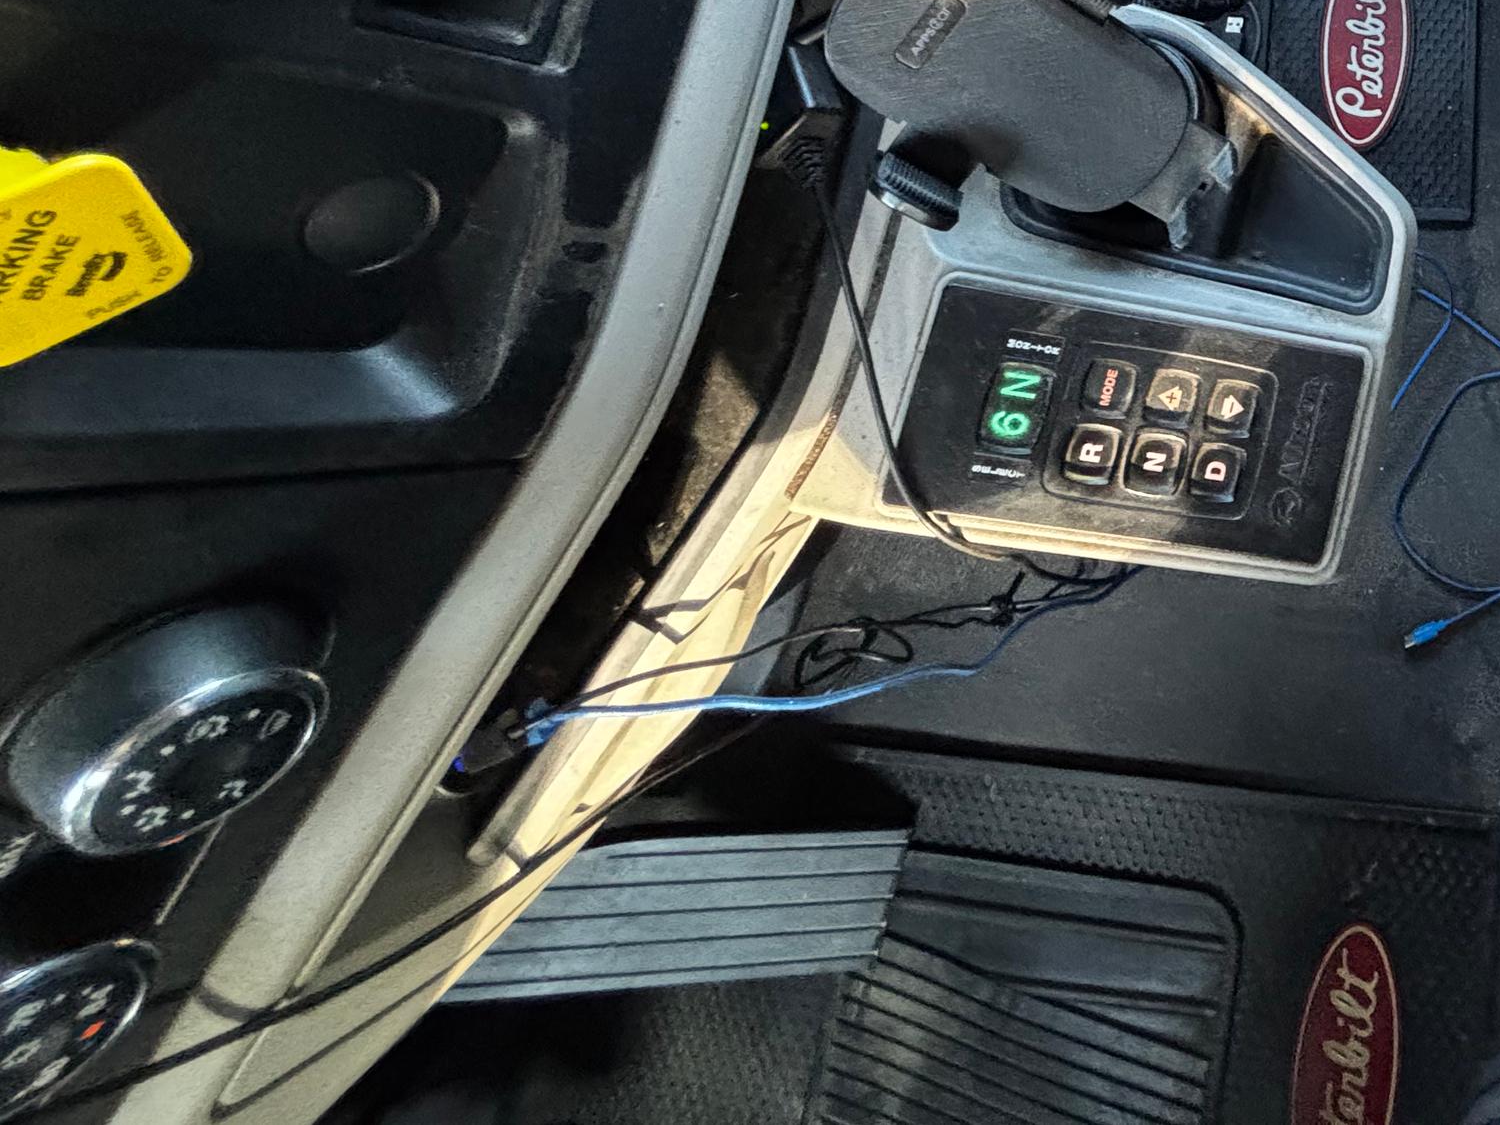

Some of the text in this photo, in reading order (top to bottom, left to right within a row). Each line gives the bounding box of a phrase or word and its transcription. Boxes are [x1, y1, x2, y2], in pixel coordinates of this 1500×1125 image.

[0, 210, 57, 302] RKING
[22, 234, 81, 301] BRAKE
[1006, 338, 1062, 356] MONITOR
[1099, 368, 1119, 407] MODE
[990, 371, 1041, 437] 6 N
[1078, 442, 1104, 464] R
[1142, 451, 1167, 473] N
[971, 464, 1026, 479] SELECT
[1204, 460, 1227, 482] D
[1319, 947, 1379, 1125] terbilt
